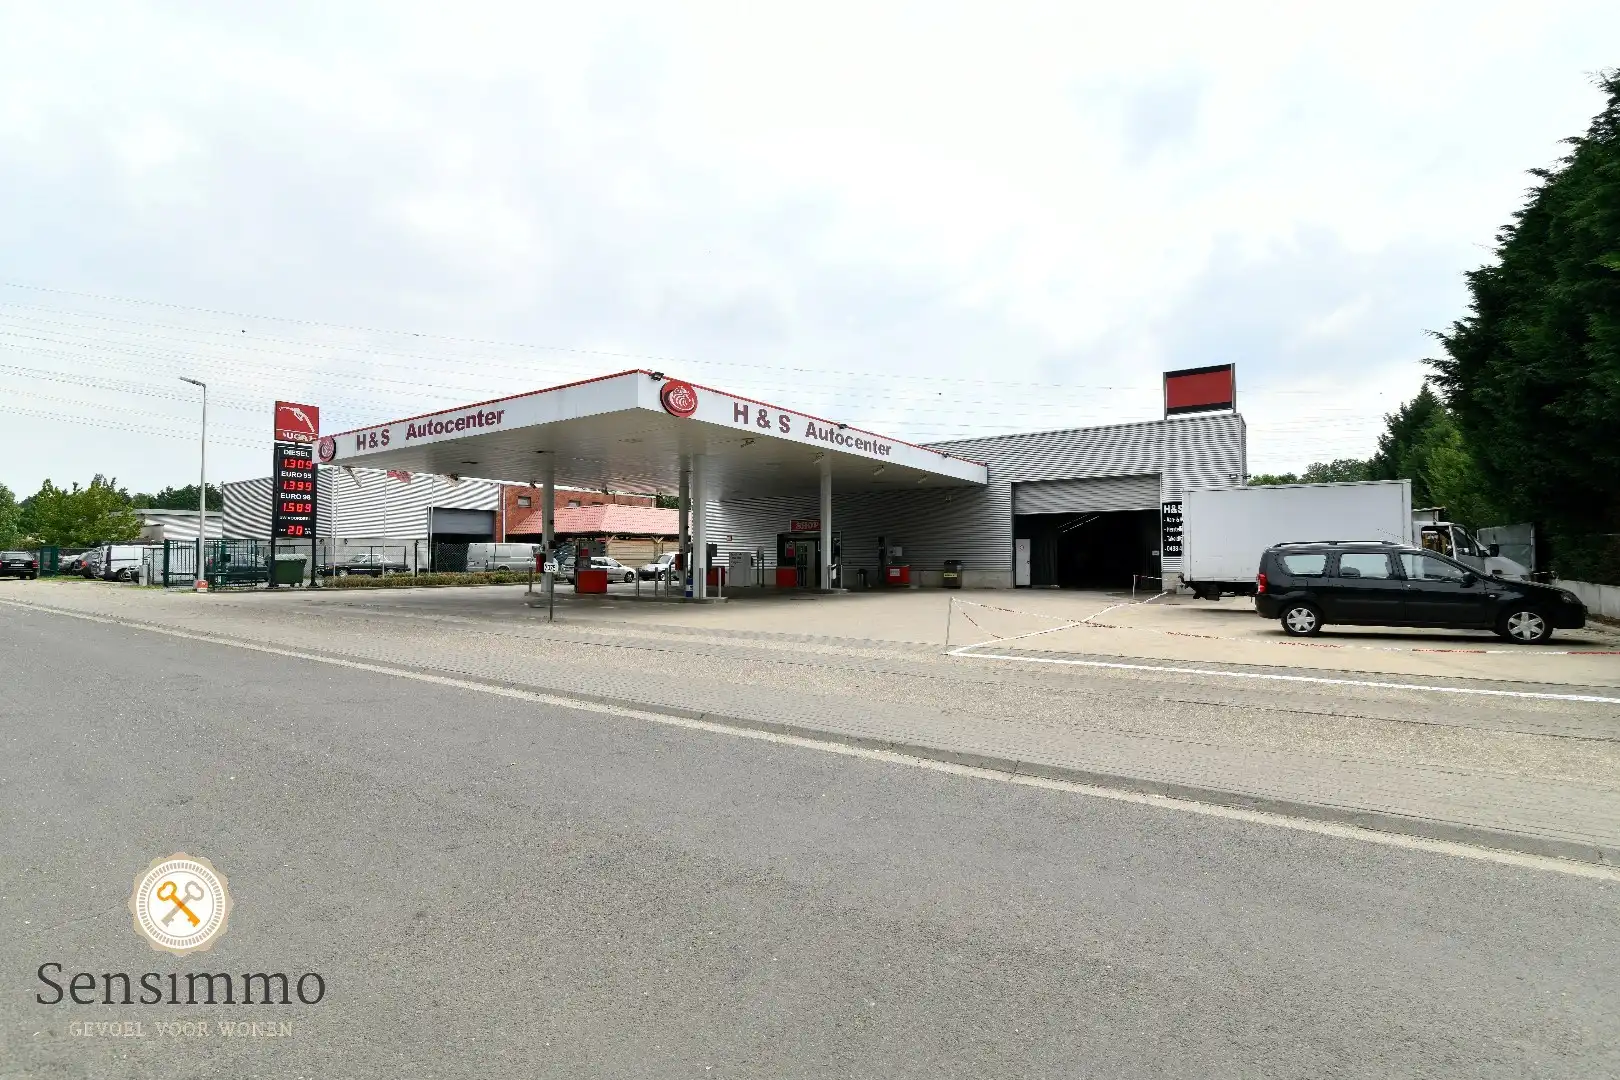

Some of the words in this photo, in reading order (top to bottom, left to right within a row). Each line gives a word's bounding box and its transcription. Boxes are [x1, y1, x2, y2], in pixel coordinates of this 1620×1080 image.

[356, 433, 367, 450] H
[368, 432, 378, 448] &
[381, 429, 390, 446] S
[405, 409, 505, 440] Autocenter
[733, 402, 749, 424] H
[756, 408, 771, 429] &
[778, 414, 791, 433] S
[805, 421, 892, 456] Autocenter
[284, 450, 310, 458] DIESEL
[281, 471, 303, 479] EURO
[280, 492, 302, 500] EURO
[795, 521, 820, 530] SHOP
